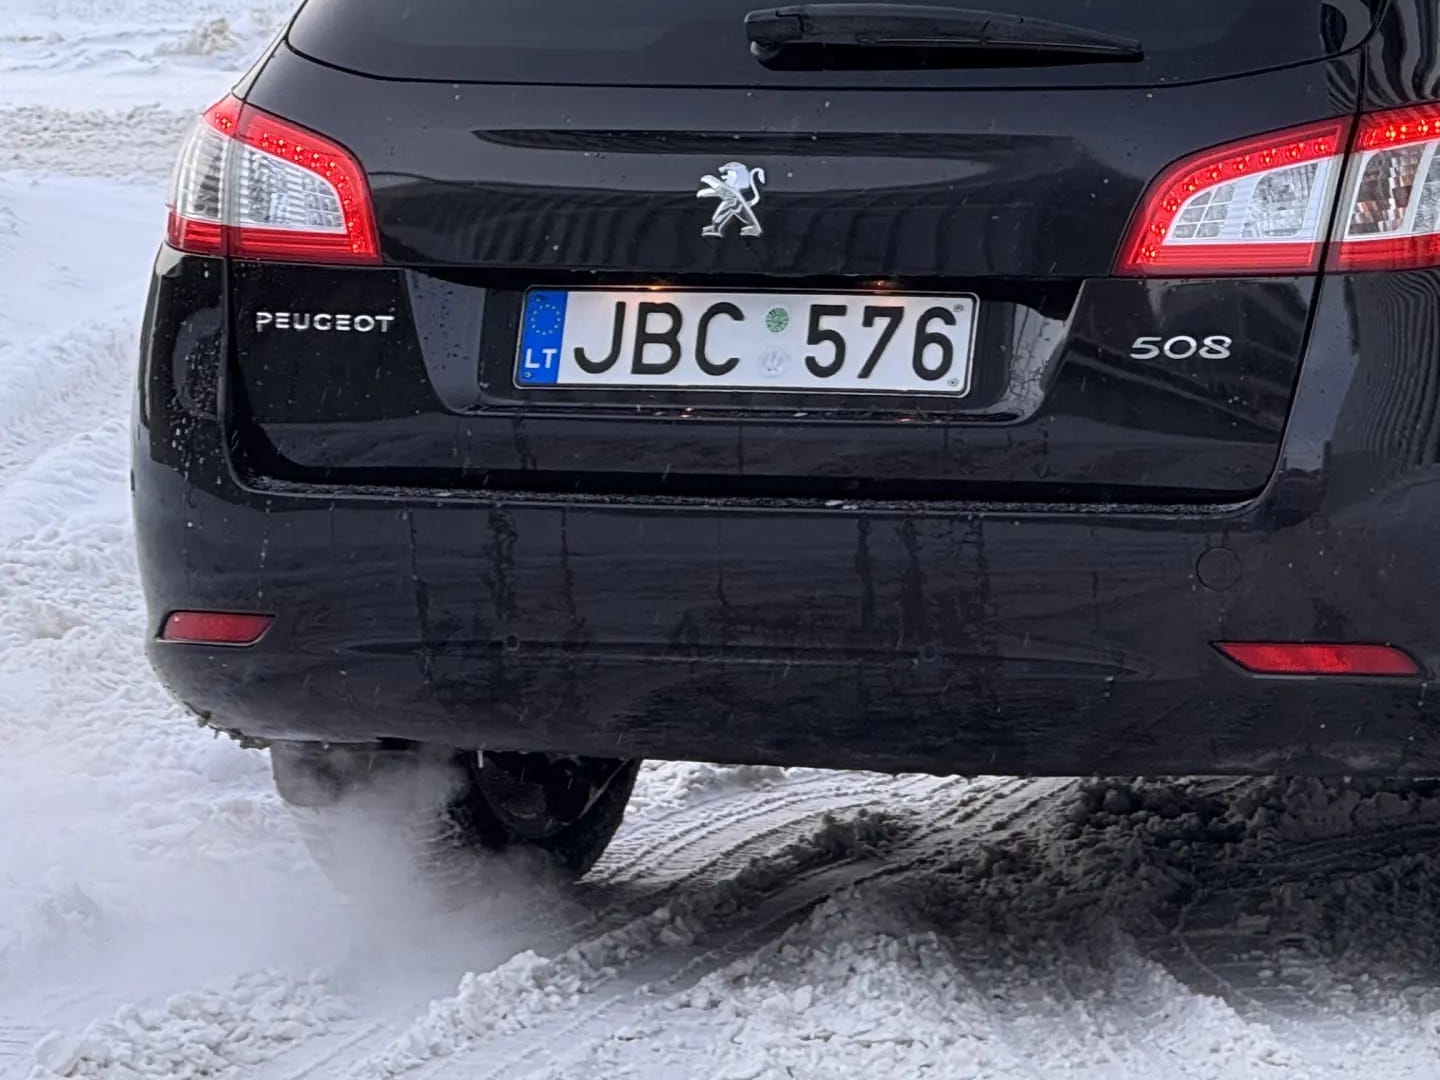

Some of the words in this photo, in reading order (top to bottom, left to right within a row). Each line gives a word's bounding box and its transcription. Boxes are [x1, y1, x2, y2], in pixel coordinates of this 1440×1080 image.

[256, 312, 395, 333] PEUGEOT
[573, 301, 746, 377] JBC
[804, 303, 958, 382] 576
[1129, 335, 1233, 360] 508
[524, 348, 558, 370] LT
